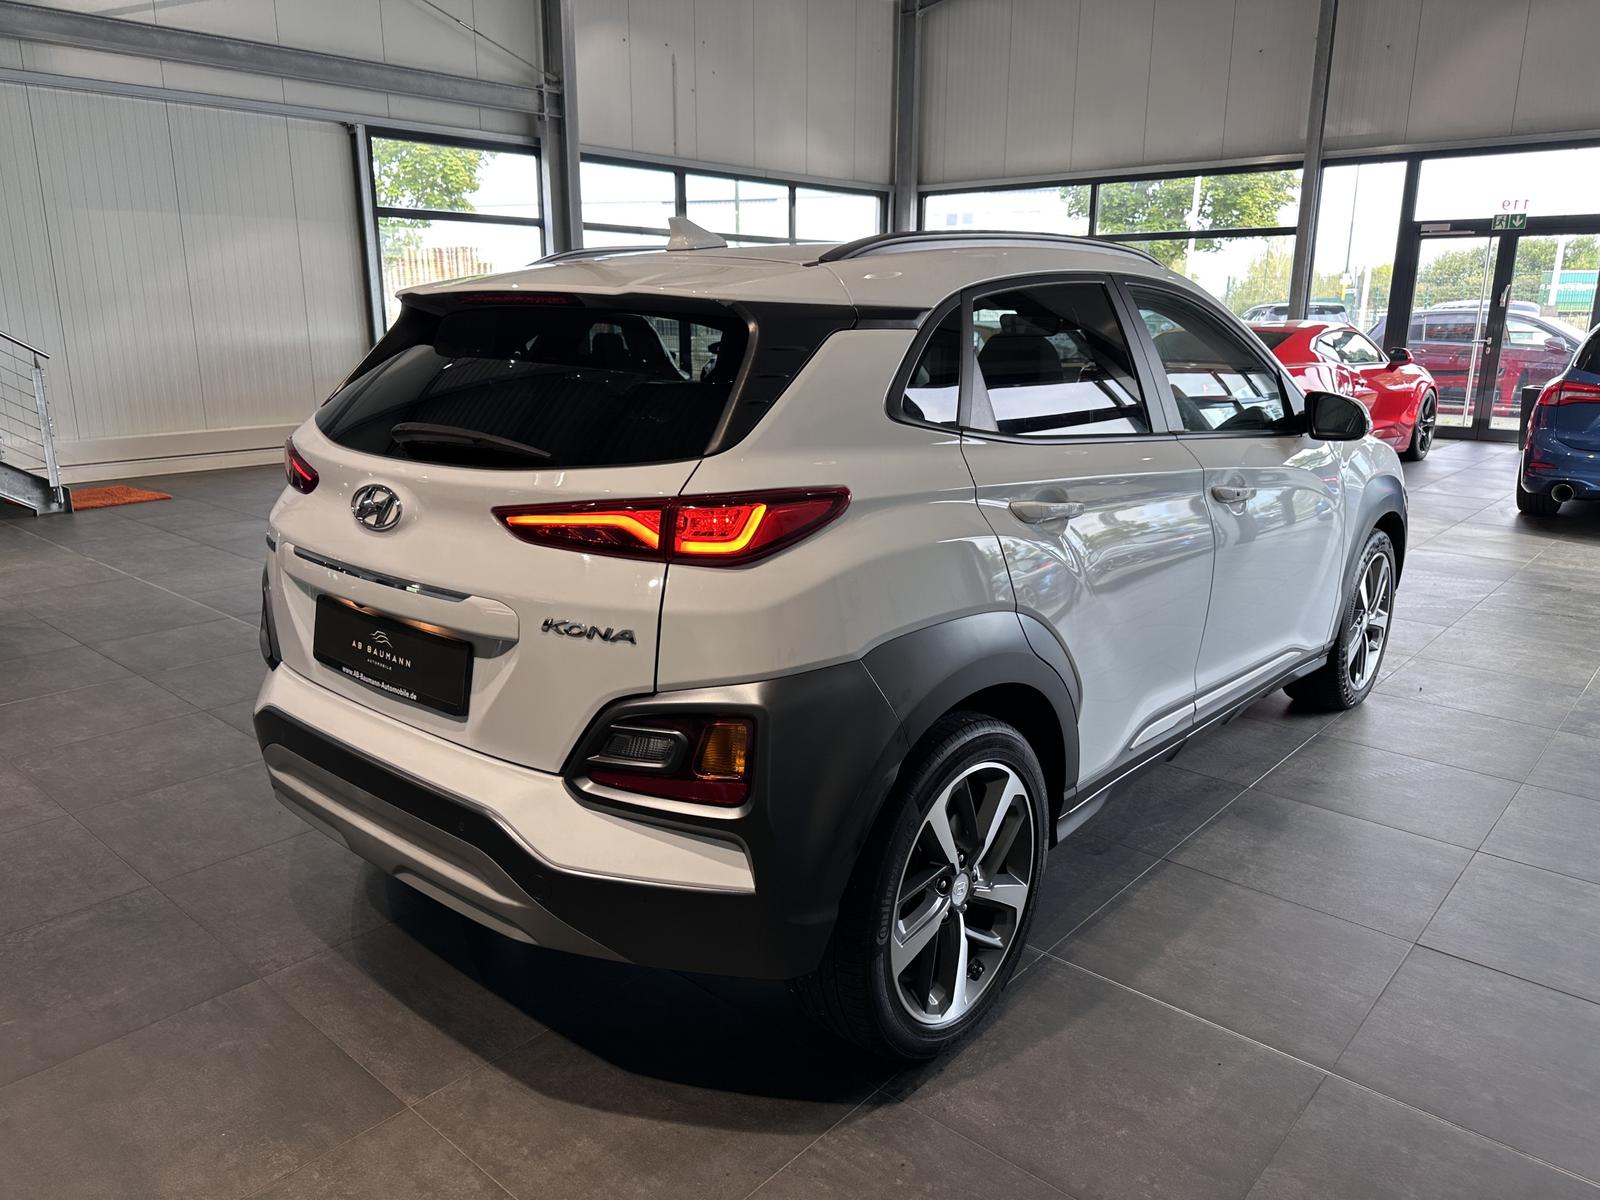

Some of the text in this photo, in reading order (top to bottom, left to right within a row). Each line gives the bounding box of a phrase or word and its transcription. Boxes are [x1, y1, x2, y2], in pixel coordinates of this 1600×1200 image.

[541, 618, 637, 645] KONA
[351, 640, 412, 668] AB BAUMANN
[342, 666, 417, 701] www.AB-Baumann-Automobile.de
